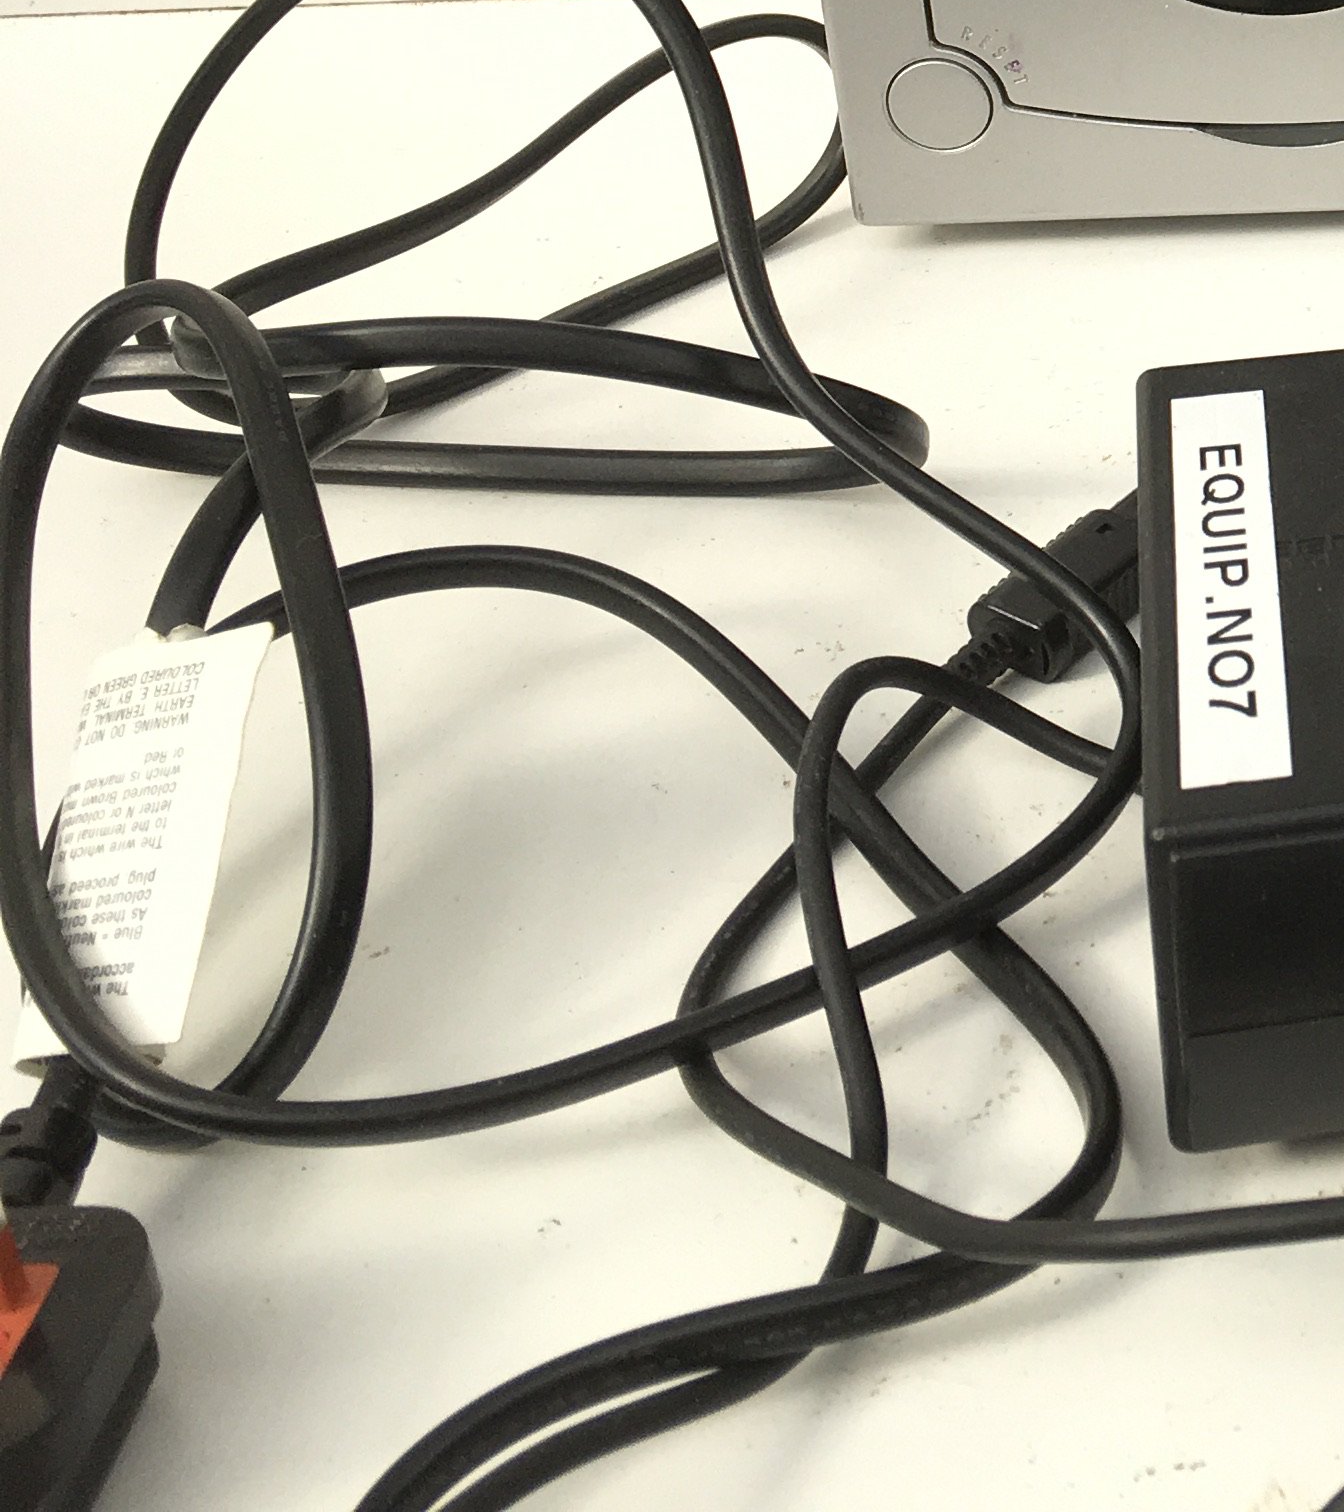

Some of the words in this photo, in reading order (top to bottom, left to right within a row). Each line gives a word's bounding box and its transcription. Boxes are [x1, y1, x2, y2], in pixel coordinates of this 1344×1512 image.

[140, 661, 205, 684] COLOURED
[103, 673, 138, 694] GREEN
[153, 677, 200, 698] LETTER
[118, 690, 133, 705] BY
[154, 694, 195, 713] EARTH
[95, 704, 146, 726] TERMINAL
[84, 729, 106, 746] NOT
[110, 723, 126, 739] DO
[145, 764, 181, 782] which
[81, 790, 118, 807] Brown
[122, 781, 177, 801] coloured
[138, 799, 172, 815] letter
[131, 819, 150, 833] the
[154, 816, 168, 829] to
[109, 838, 136, 853] wire
[140, 834, 163, 849] The
[69, 843, 105, 861] which
[68, 873, 120, 895] proceed
[95, 888, 152, 908] coloured
[91, 909, 126, 925] these
[131, 907, 148, 921] As
[113, 925, 143, 940] Blue
[105, 980, 129, 996] The
